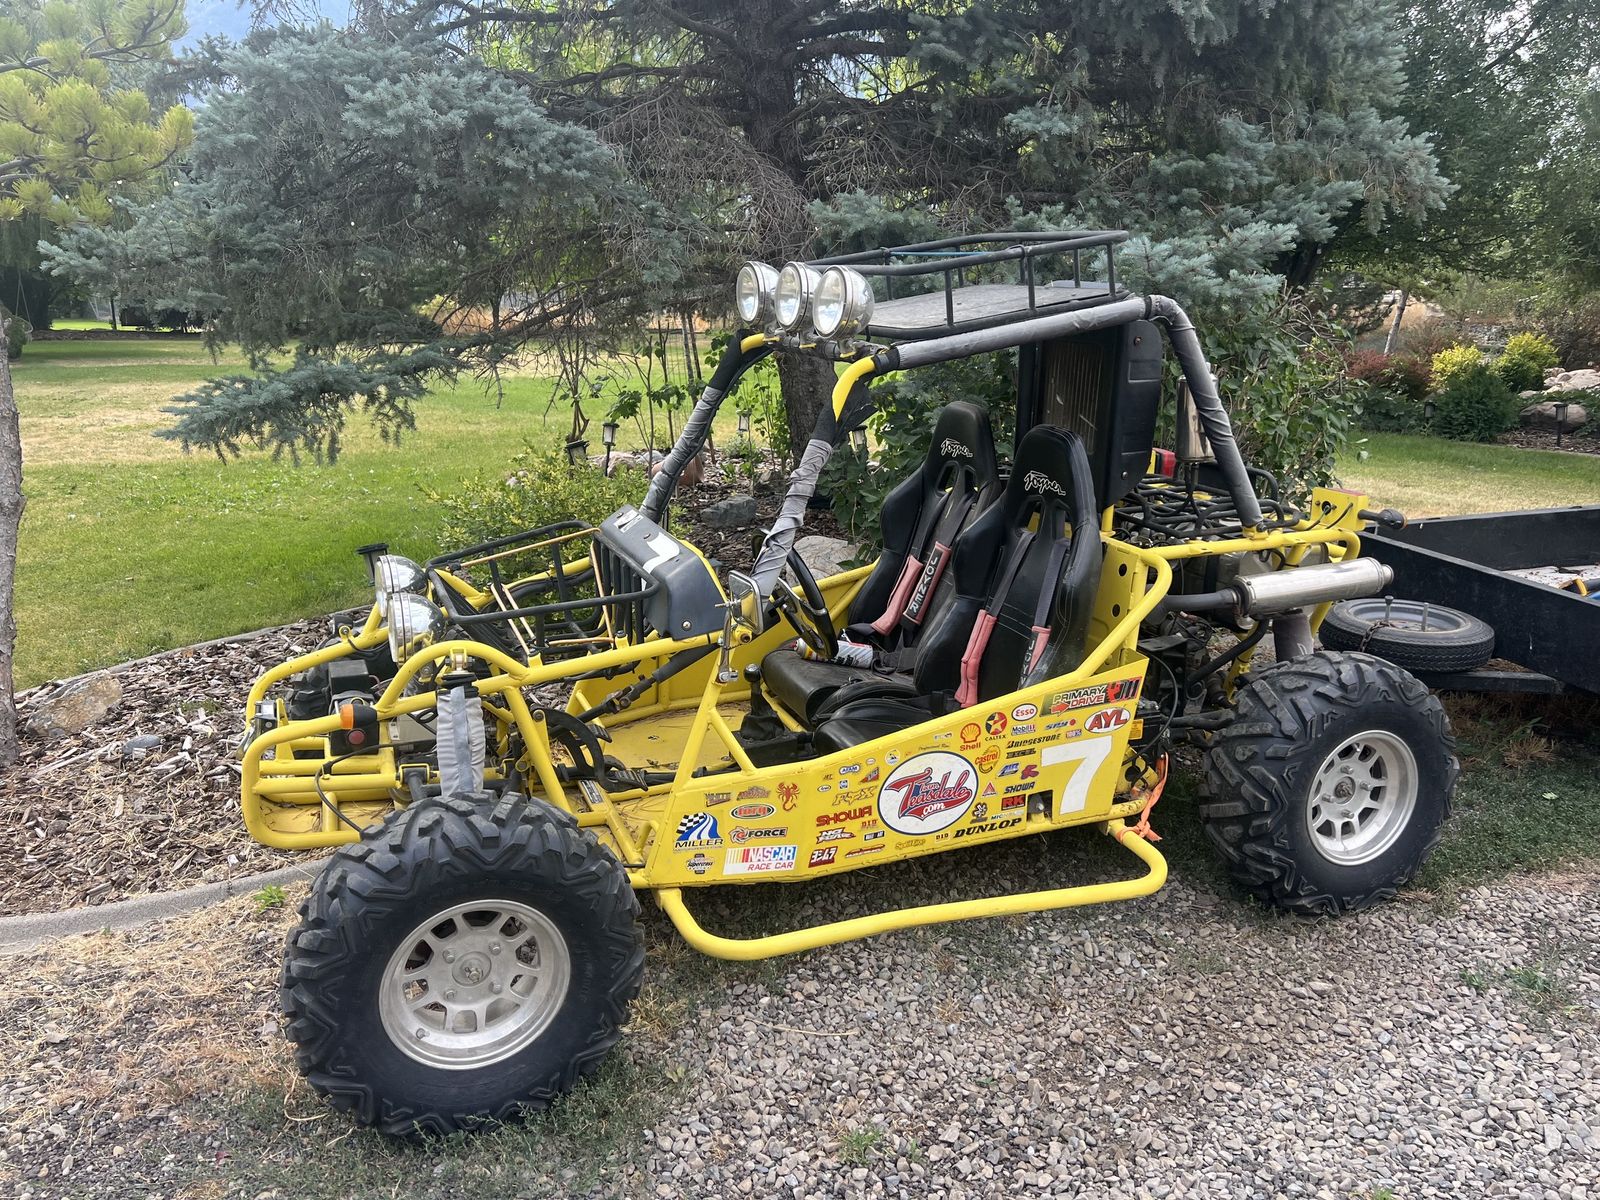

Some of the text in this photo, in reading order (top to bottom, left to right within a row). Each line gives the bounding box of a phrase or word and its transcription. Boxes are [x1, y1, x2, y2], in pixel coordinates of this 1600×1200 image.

[1024, 470, 1066, 496] Joyner
[905, 556, 938, 613] JOYNER
[1054, 684, 1107, 703] PRIMARY
[1071, 694, 1105, 708] DRIVE
[1088, 708, 1128, 732] AYL
[960, 743, 981, 752] Shell
[1007, 734, 1061, 749] BRIDGESTONE
[975, 751, 998, 765] Castrol
[1041, 735, 1113, 815] 7
[884, 767, 972, 818] Teasdale
[1004, 782, 1035, 794] SHOWA
[816, 805, 872, 827] SHOWA
[748, 828, 787, 838] FORCE
[954, 818, 1022, 838] DUNLOP
[675, 838, 723, 848] MILLER
[749, 846, 797, 861] NASCAR
[775, 861, 794, 869] CAR
